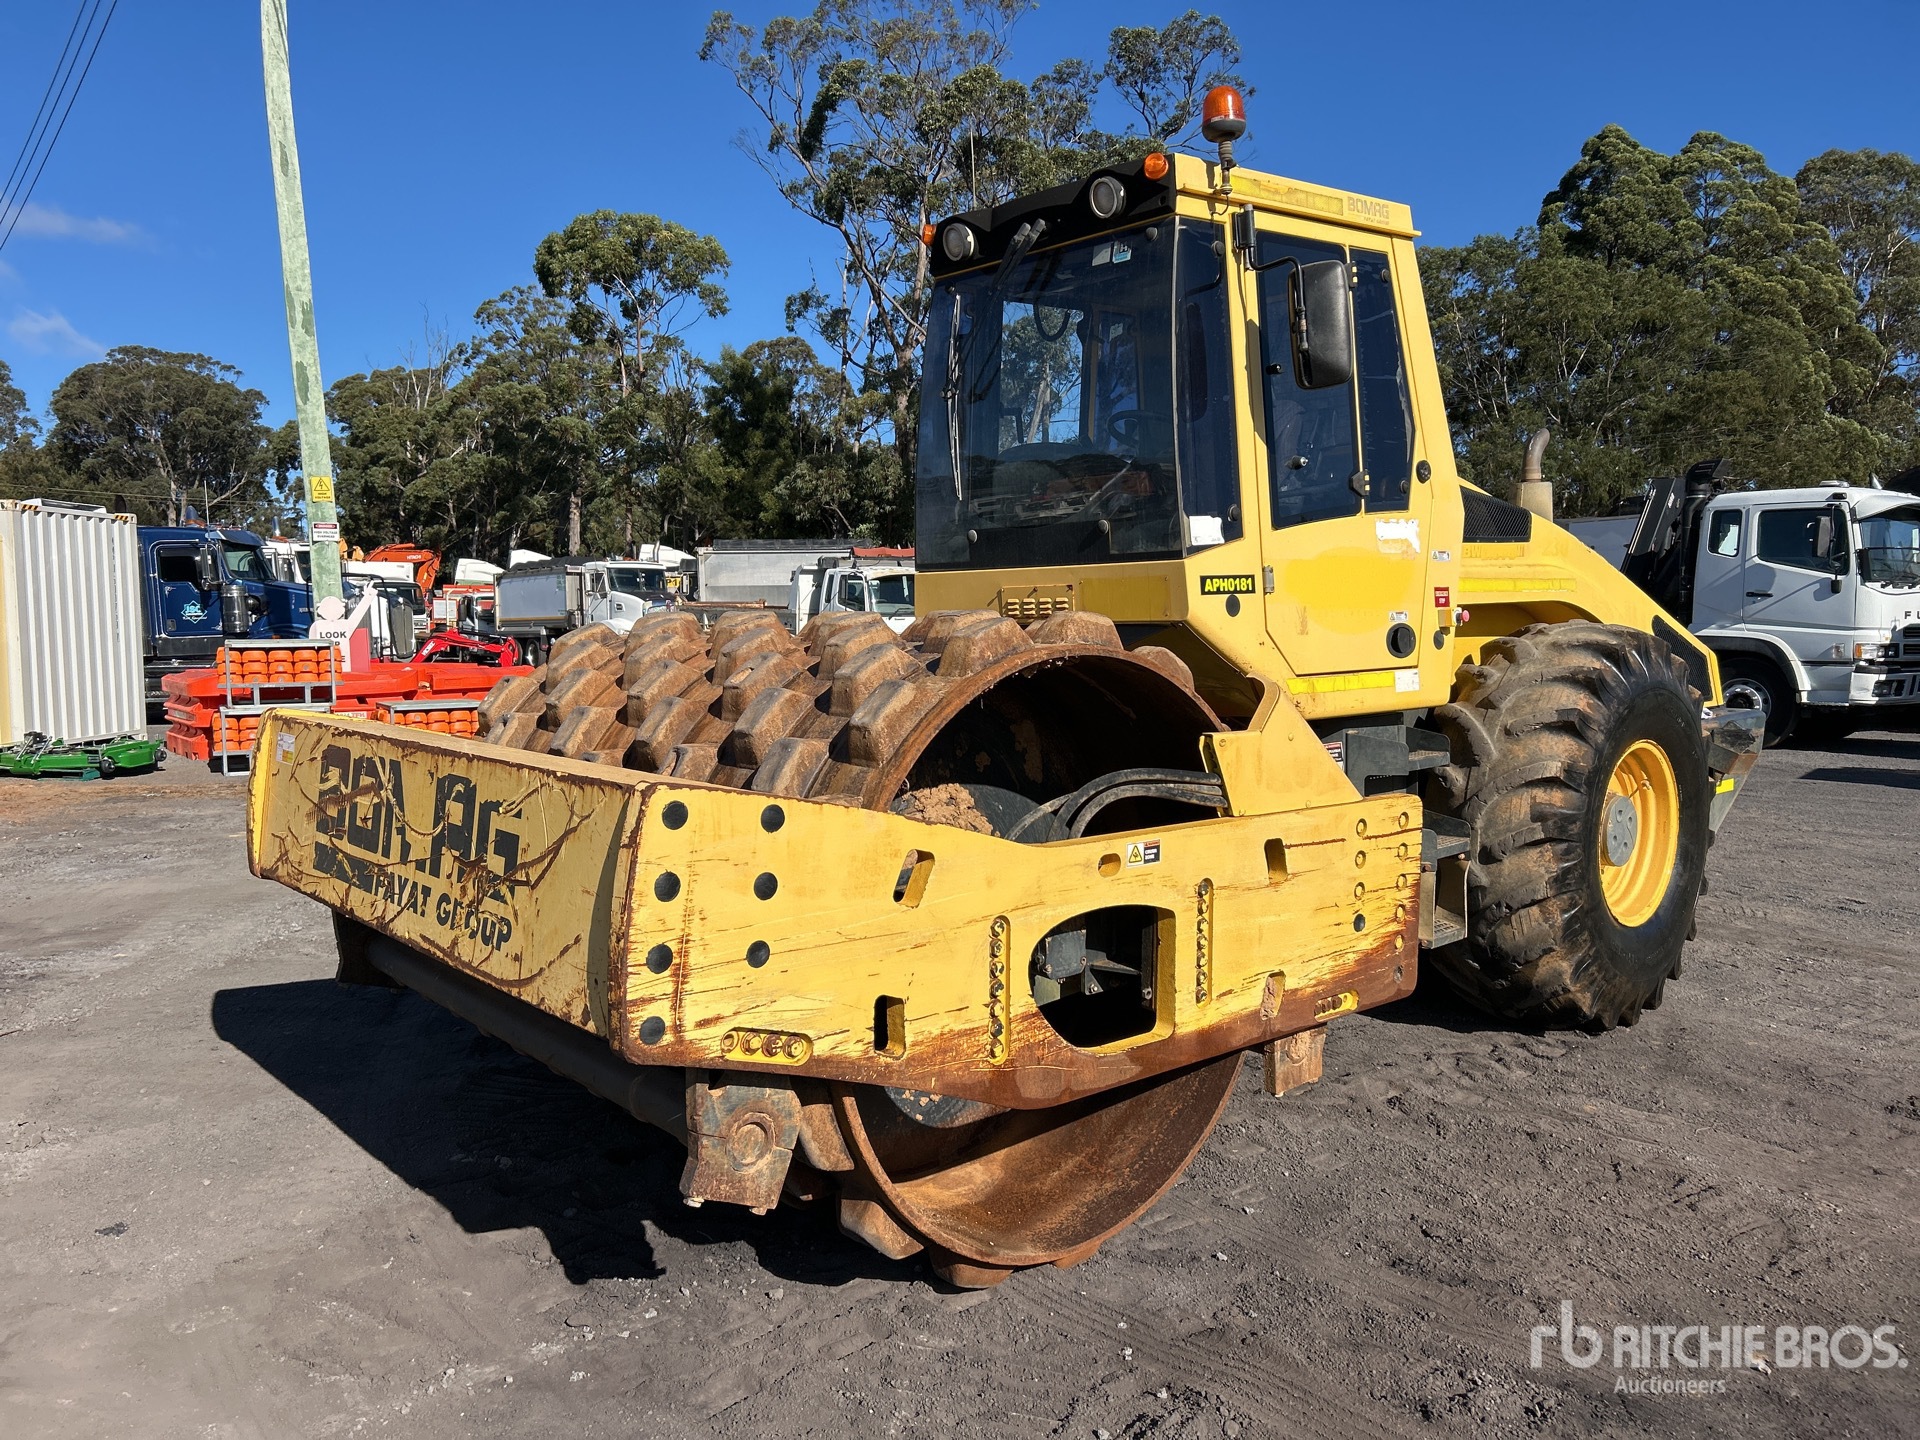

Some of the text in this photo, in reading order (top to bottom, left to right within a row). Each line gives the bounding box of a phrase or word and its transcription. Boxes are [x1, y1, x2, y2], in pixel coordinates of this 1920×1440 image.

[1347, 196, 1389, 219] BOMAG
[1204, 577, 1253, 592] APH0181
[320, 631, 347, 639] LOOK
